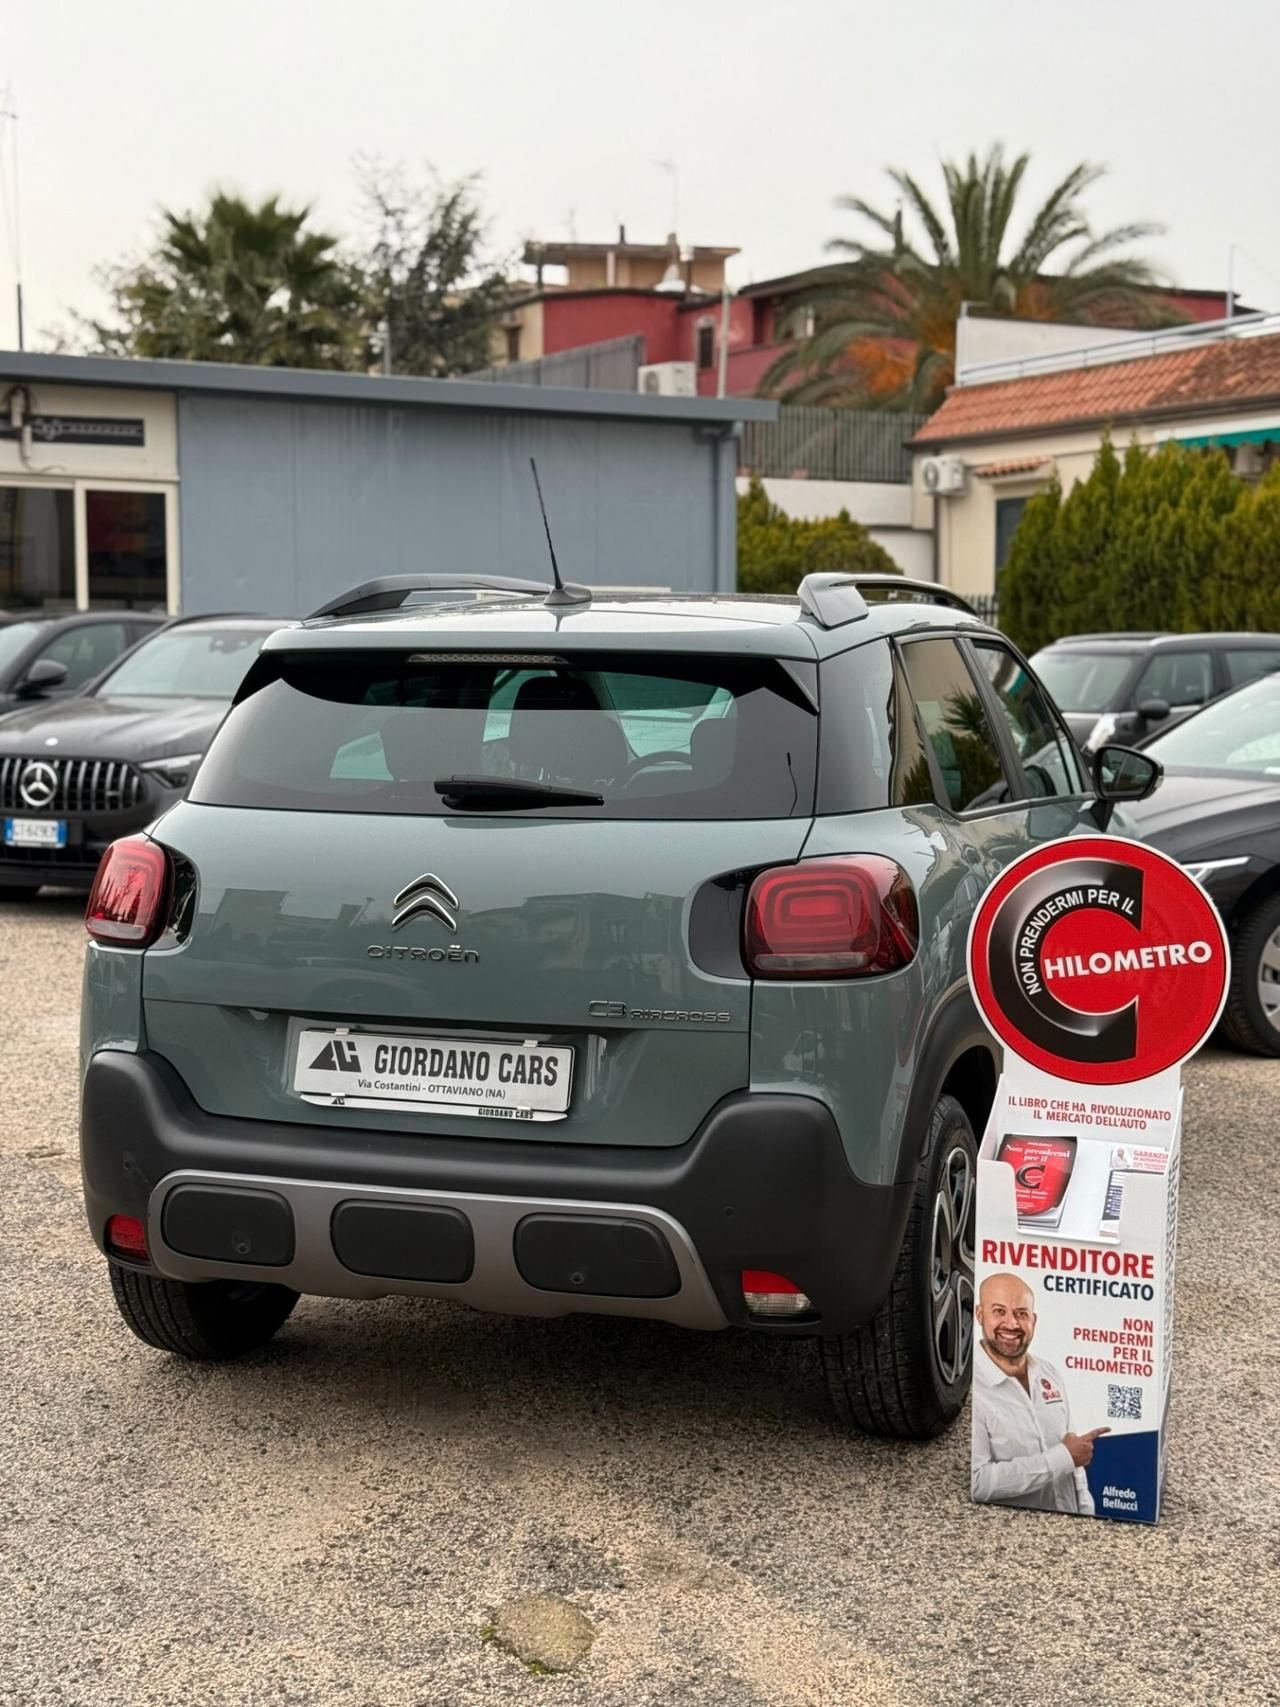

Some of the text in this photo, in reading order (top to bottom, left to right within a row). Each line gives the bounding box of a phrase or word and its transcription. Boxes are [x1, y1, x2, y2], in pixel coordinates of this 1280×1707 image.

[1020, 889, 1136, 995] NON PRENDERMI PER IL
[588, 1000, 731, 1023] C3 AIRCROSS
[374, 1044, 490, 1081] GIORDANO
[499, 1053, 559, 1087] CARS
[357, 1079, 373, 1089] Via
[374, 1080, 421, 1093] Costantini
[428, 1084, 483, 1097] OTTAVIANO
[485, 1088, 506, 1100] (NA)
[478, 1108, 514, 1118] GIORDANO
[515, 1110, 535, 1119] CARS
[1008, 1095, 1171, 1121] IL LIBRO CHE HA RIVOLUZIONATO
[1033, 1110, 1147, 1130] IL MERCATO DELL'AUTO
[982, 1239, 1154, 1279] RIVENDITORE
[1043, 1275, 1154, 1301] CERTIFICATO
[1123, 1318, 1154, 1333] NON
[1073, 1327, 1153, 1348] PRENDERMI
[1113, 1347, 1154, 1362] PER IL
[1065, 1355, 1153, 1377] CHILOMETRO
[1102, 1485, 1136, 1499] Alfredo
[1103, 1497, 1138, 1511] Bellucci
